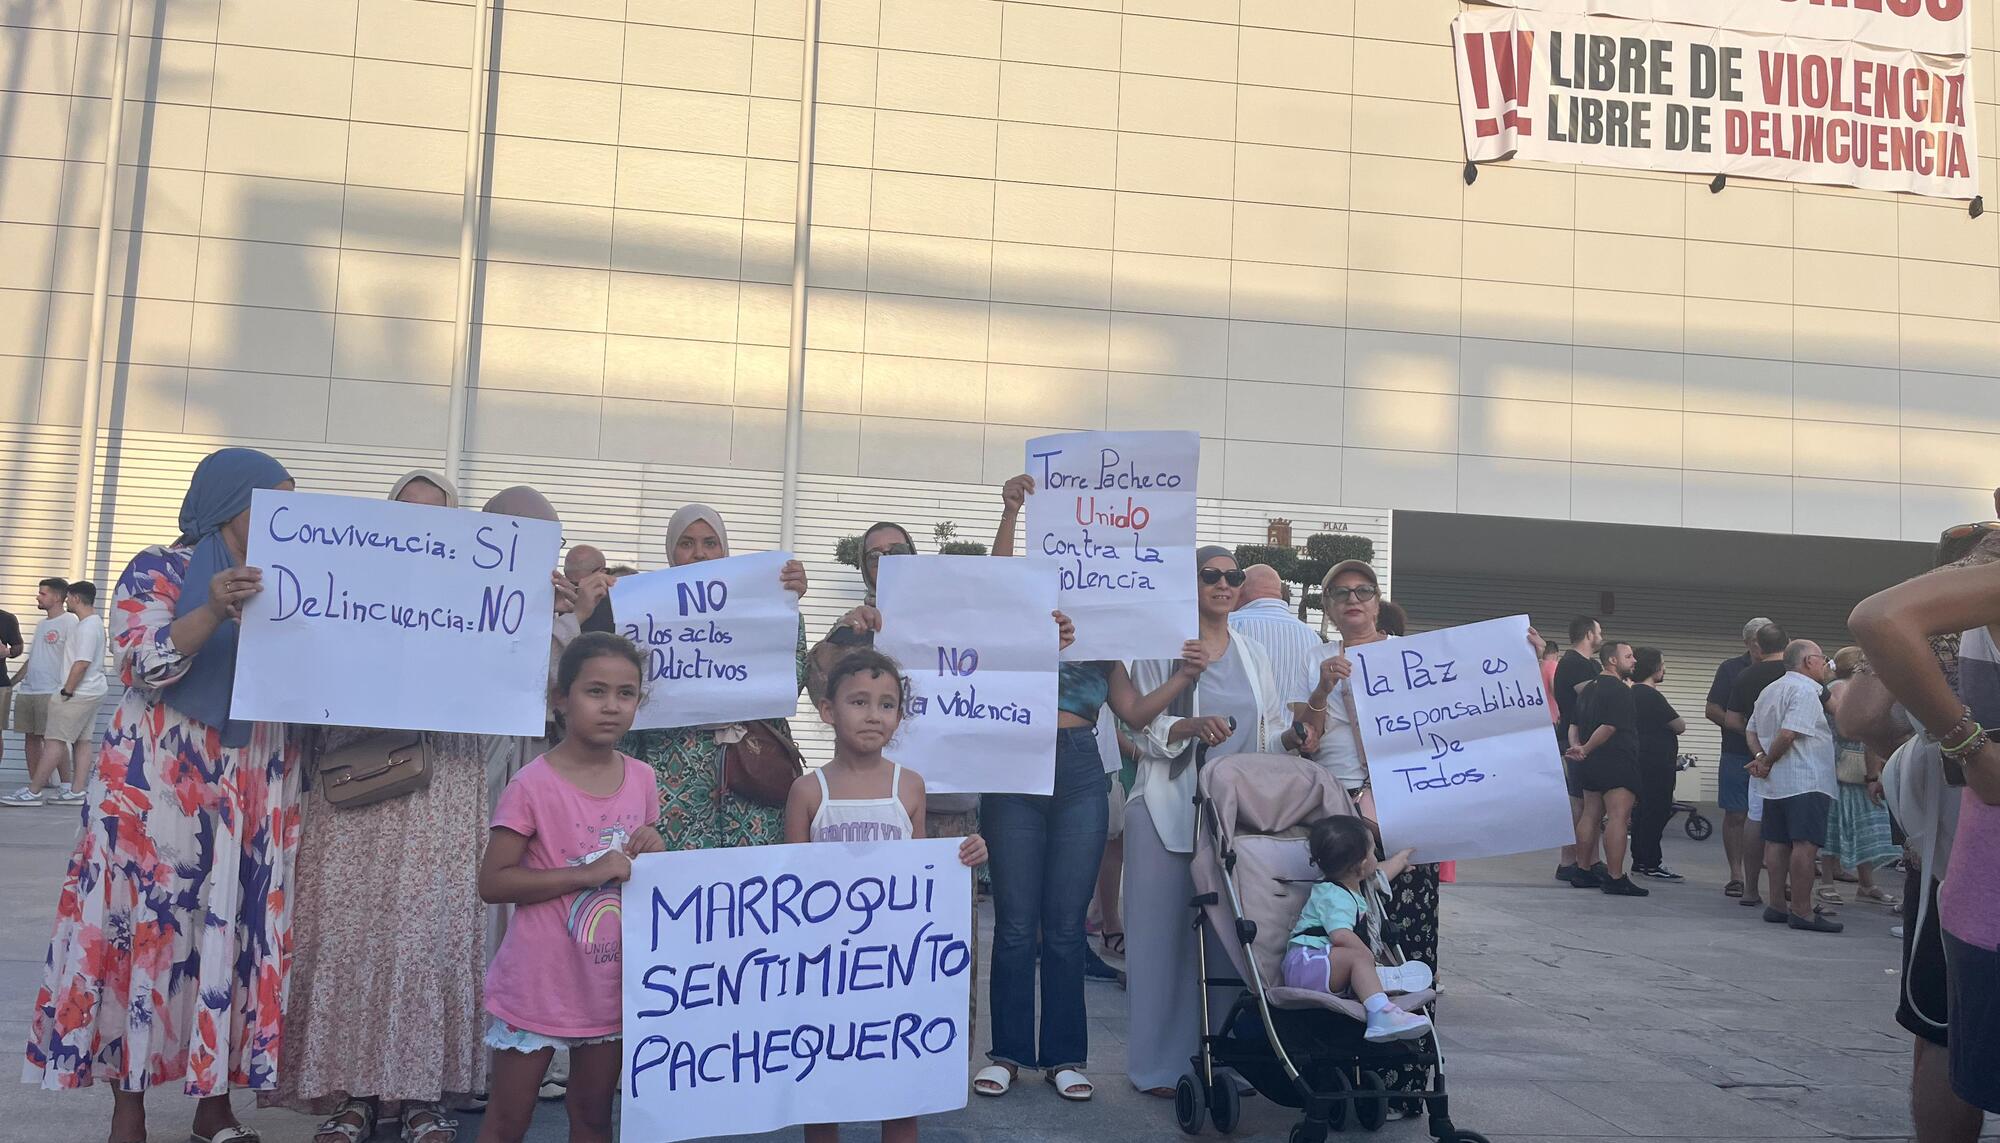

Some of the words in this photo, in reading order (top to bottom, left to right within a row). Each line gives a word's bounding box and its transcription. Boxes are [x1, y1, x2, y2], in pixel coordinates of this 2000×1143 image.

[1550, 31, 1673, 97] LIBRE
[1690, 43, 1743, 102] DE
[1758, 50, 1966, 127] VIOLENCIA
[1547, 93, 1652, 149] LIBRE
[1665, 103, 1712, 153] DE
[1726, 109, 1971, 179] DELINCUENCIA
[1033, 450, 1089, 490] Torre
[1094, 448, 1182, 490] Pacheco
[1323, 521, 1348, 531] PLAZA
[677, 580, 728, 616] NO
[647, 613, 673, 645] los
[938, 646, 979, 678] NO
[1401, 650, 1458, 690] Paz
[1482, 658, 1508, 675] es
[937, 685, 1032, 725] violencia
[1428, 733, 1465, 759] De
[594, 952, 621, 965] LOVE
[631, 1012, 957, 1098] PACHEQUERO
